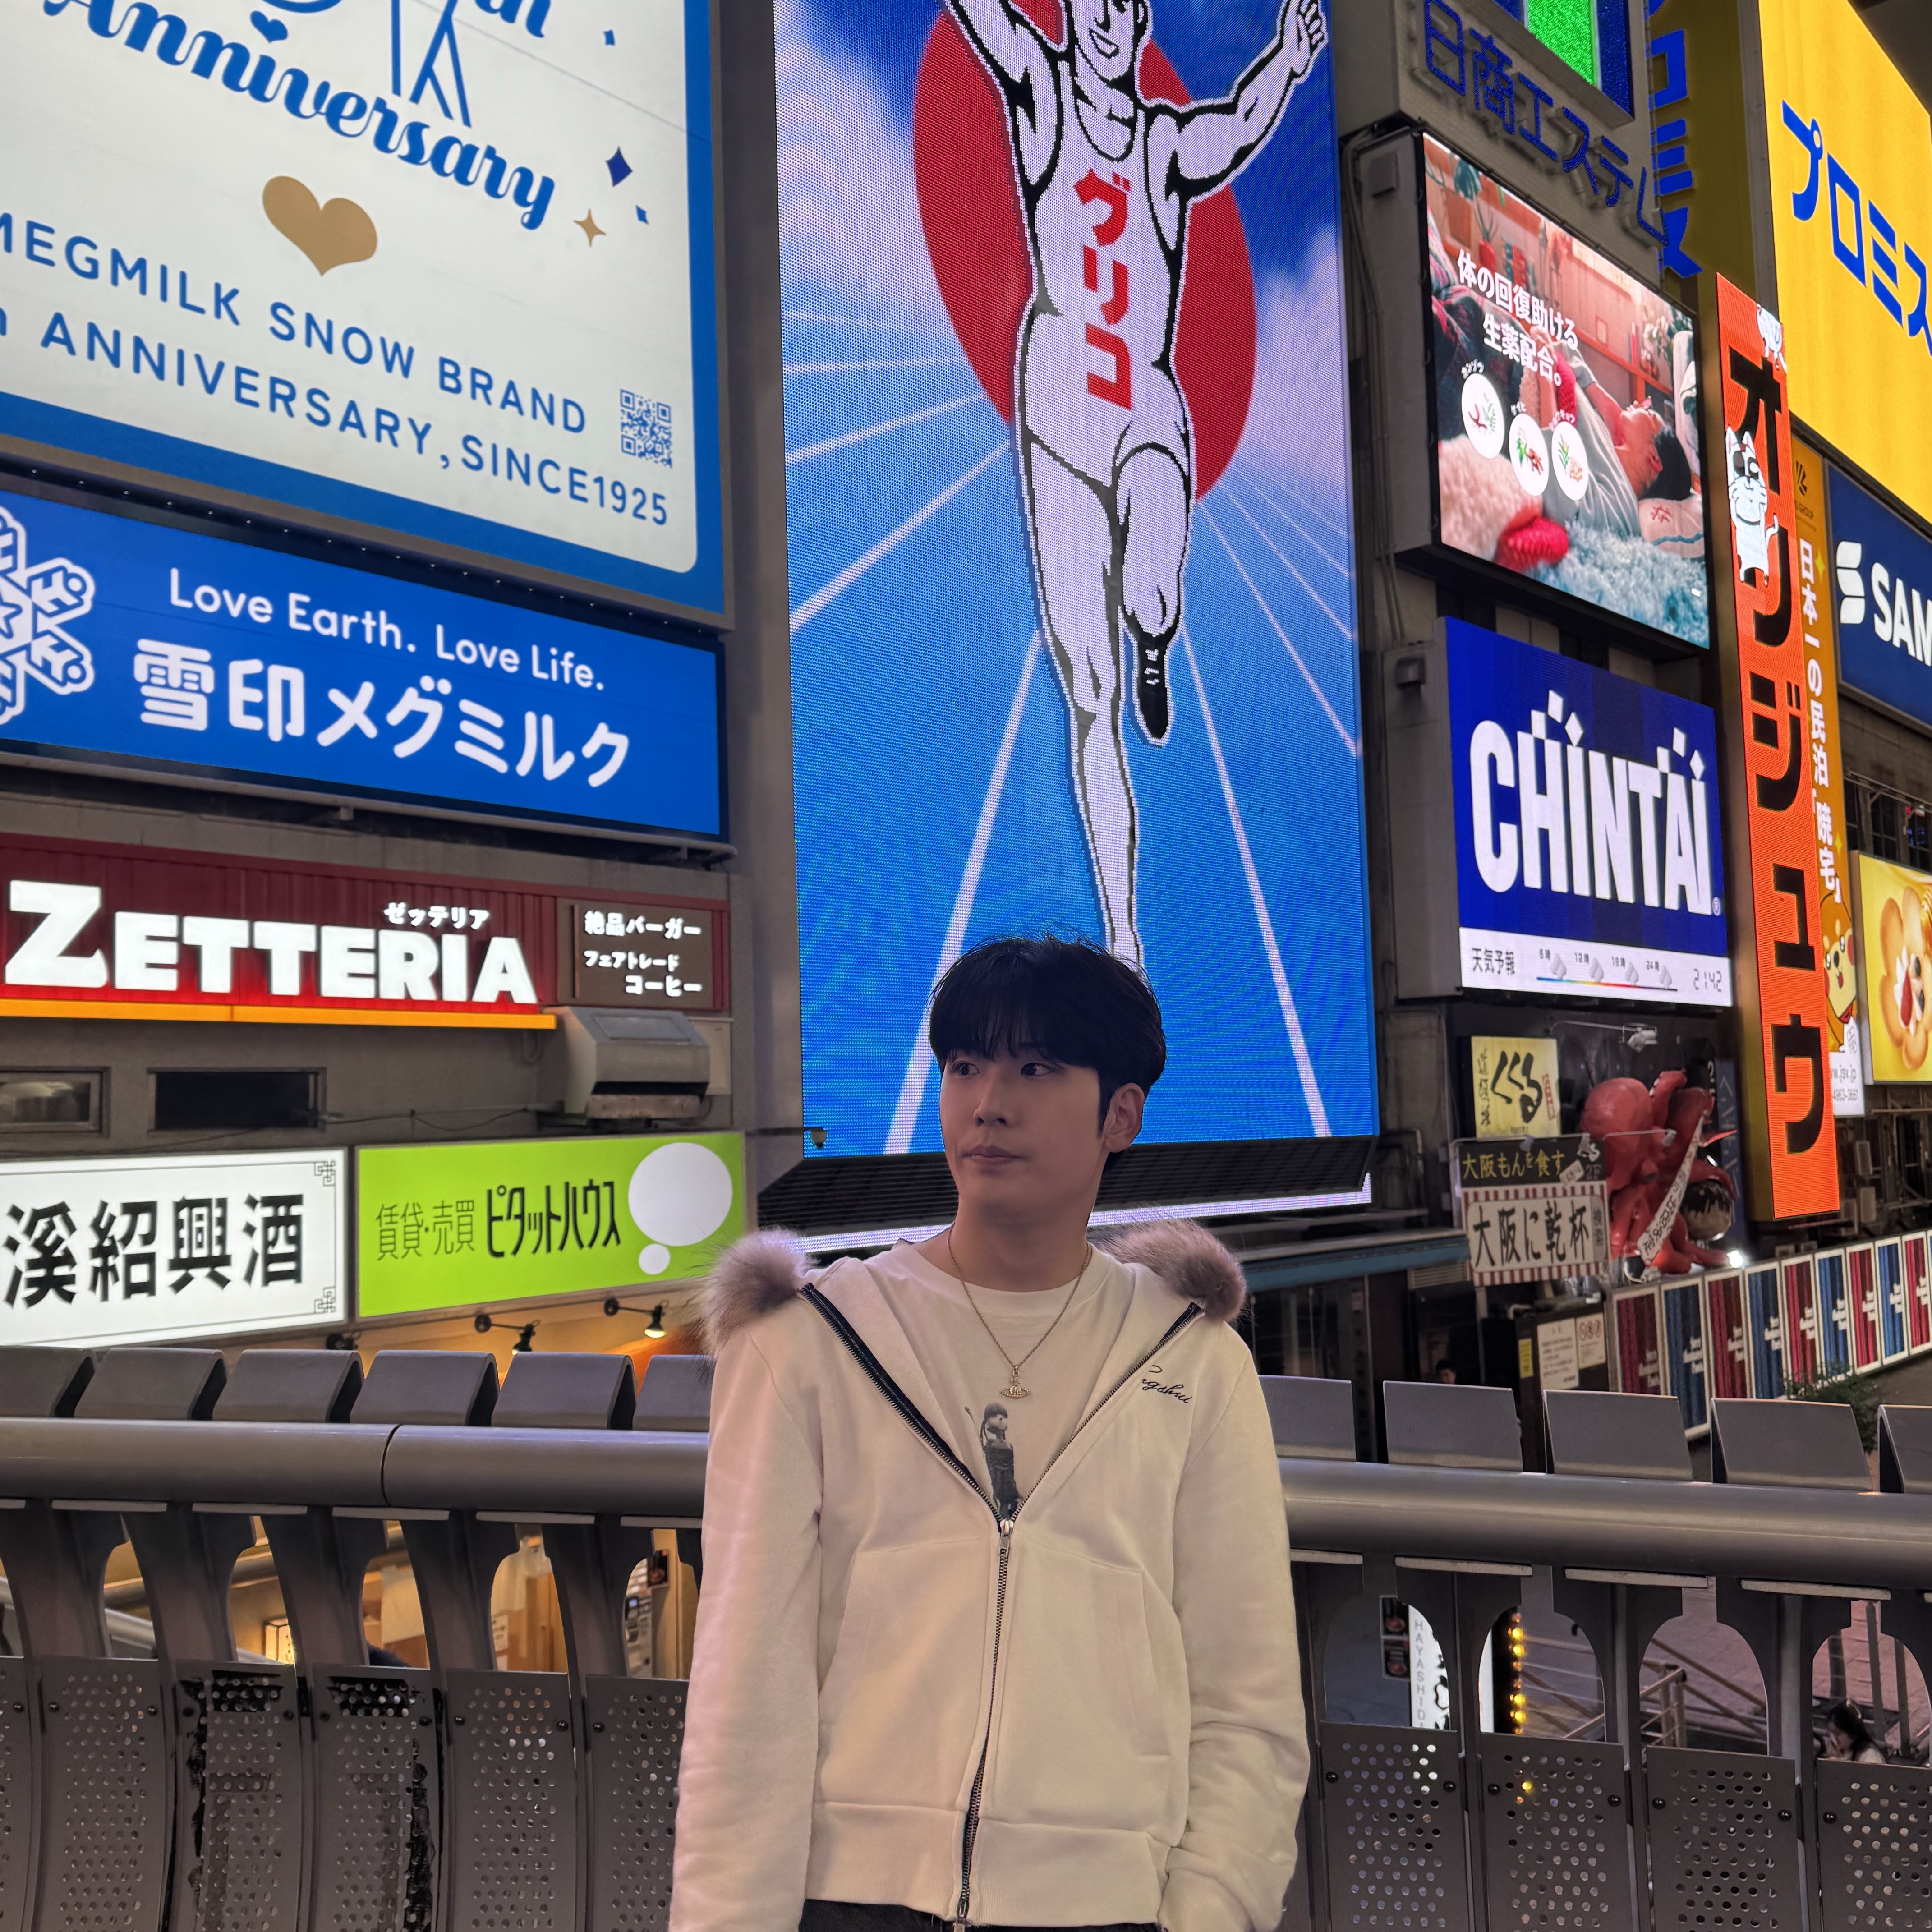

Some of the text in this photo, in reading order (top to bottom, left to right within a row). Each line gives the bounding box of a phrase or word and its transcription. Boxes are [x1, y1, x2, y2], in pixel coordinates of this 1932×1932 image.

[1782, 100, 1932, 357] プロミス
[1073, 169, 1132, 411] グリコ
[1457, 248, 1578, 350] 体の回復助ける
[269, 302, 414, 379] SNOW
[439, 356, 585, 433] BRAND
[170, 568, 604, 690] Love Earth. Love Life.
[133, 639, 629, 788] 雪印メグミルク
[5, 879, 538, 1004] ZETTERIA
[584, 910, 702, 940] 絶品バーガー
[584, 950, 680, 972] フェアトレード
[1472, 948, 1515, 975] 天気予報
[625, 975, 703, 997] コーヒー
[487, 1179, 621, 1259] ピタットハウス
[1473, 1199, 1589, 1267] 大阪に乾杯
[1415, 1618, 1426, 1727] HAYASHID
